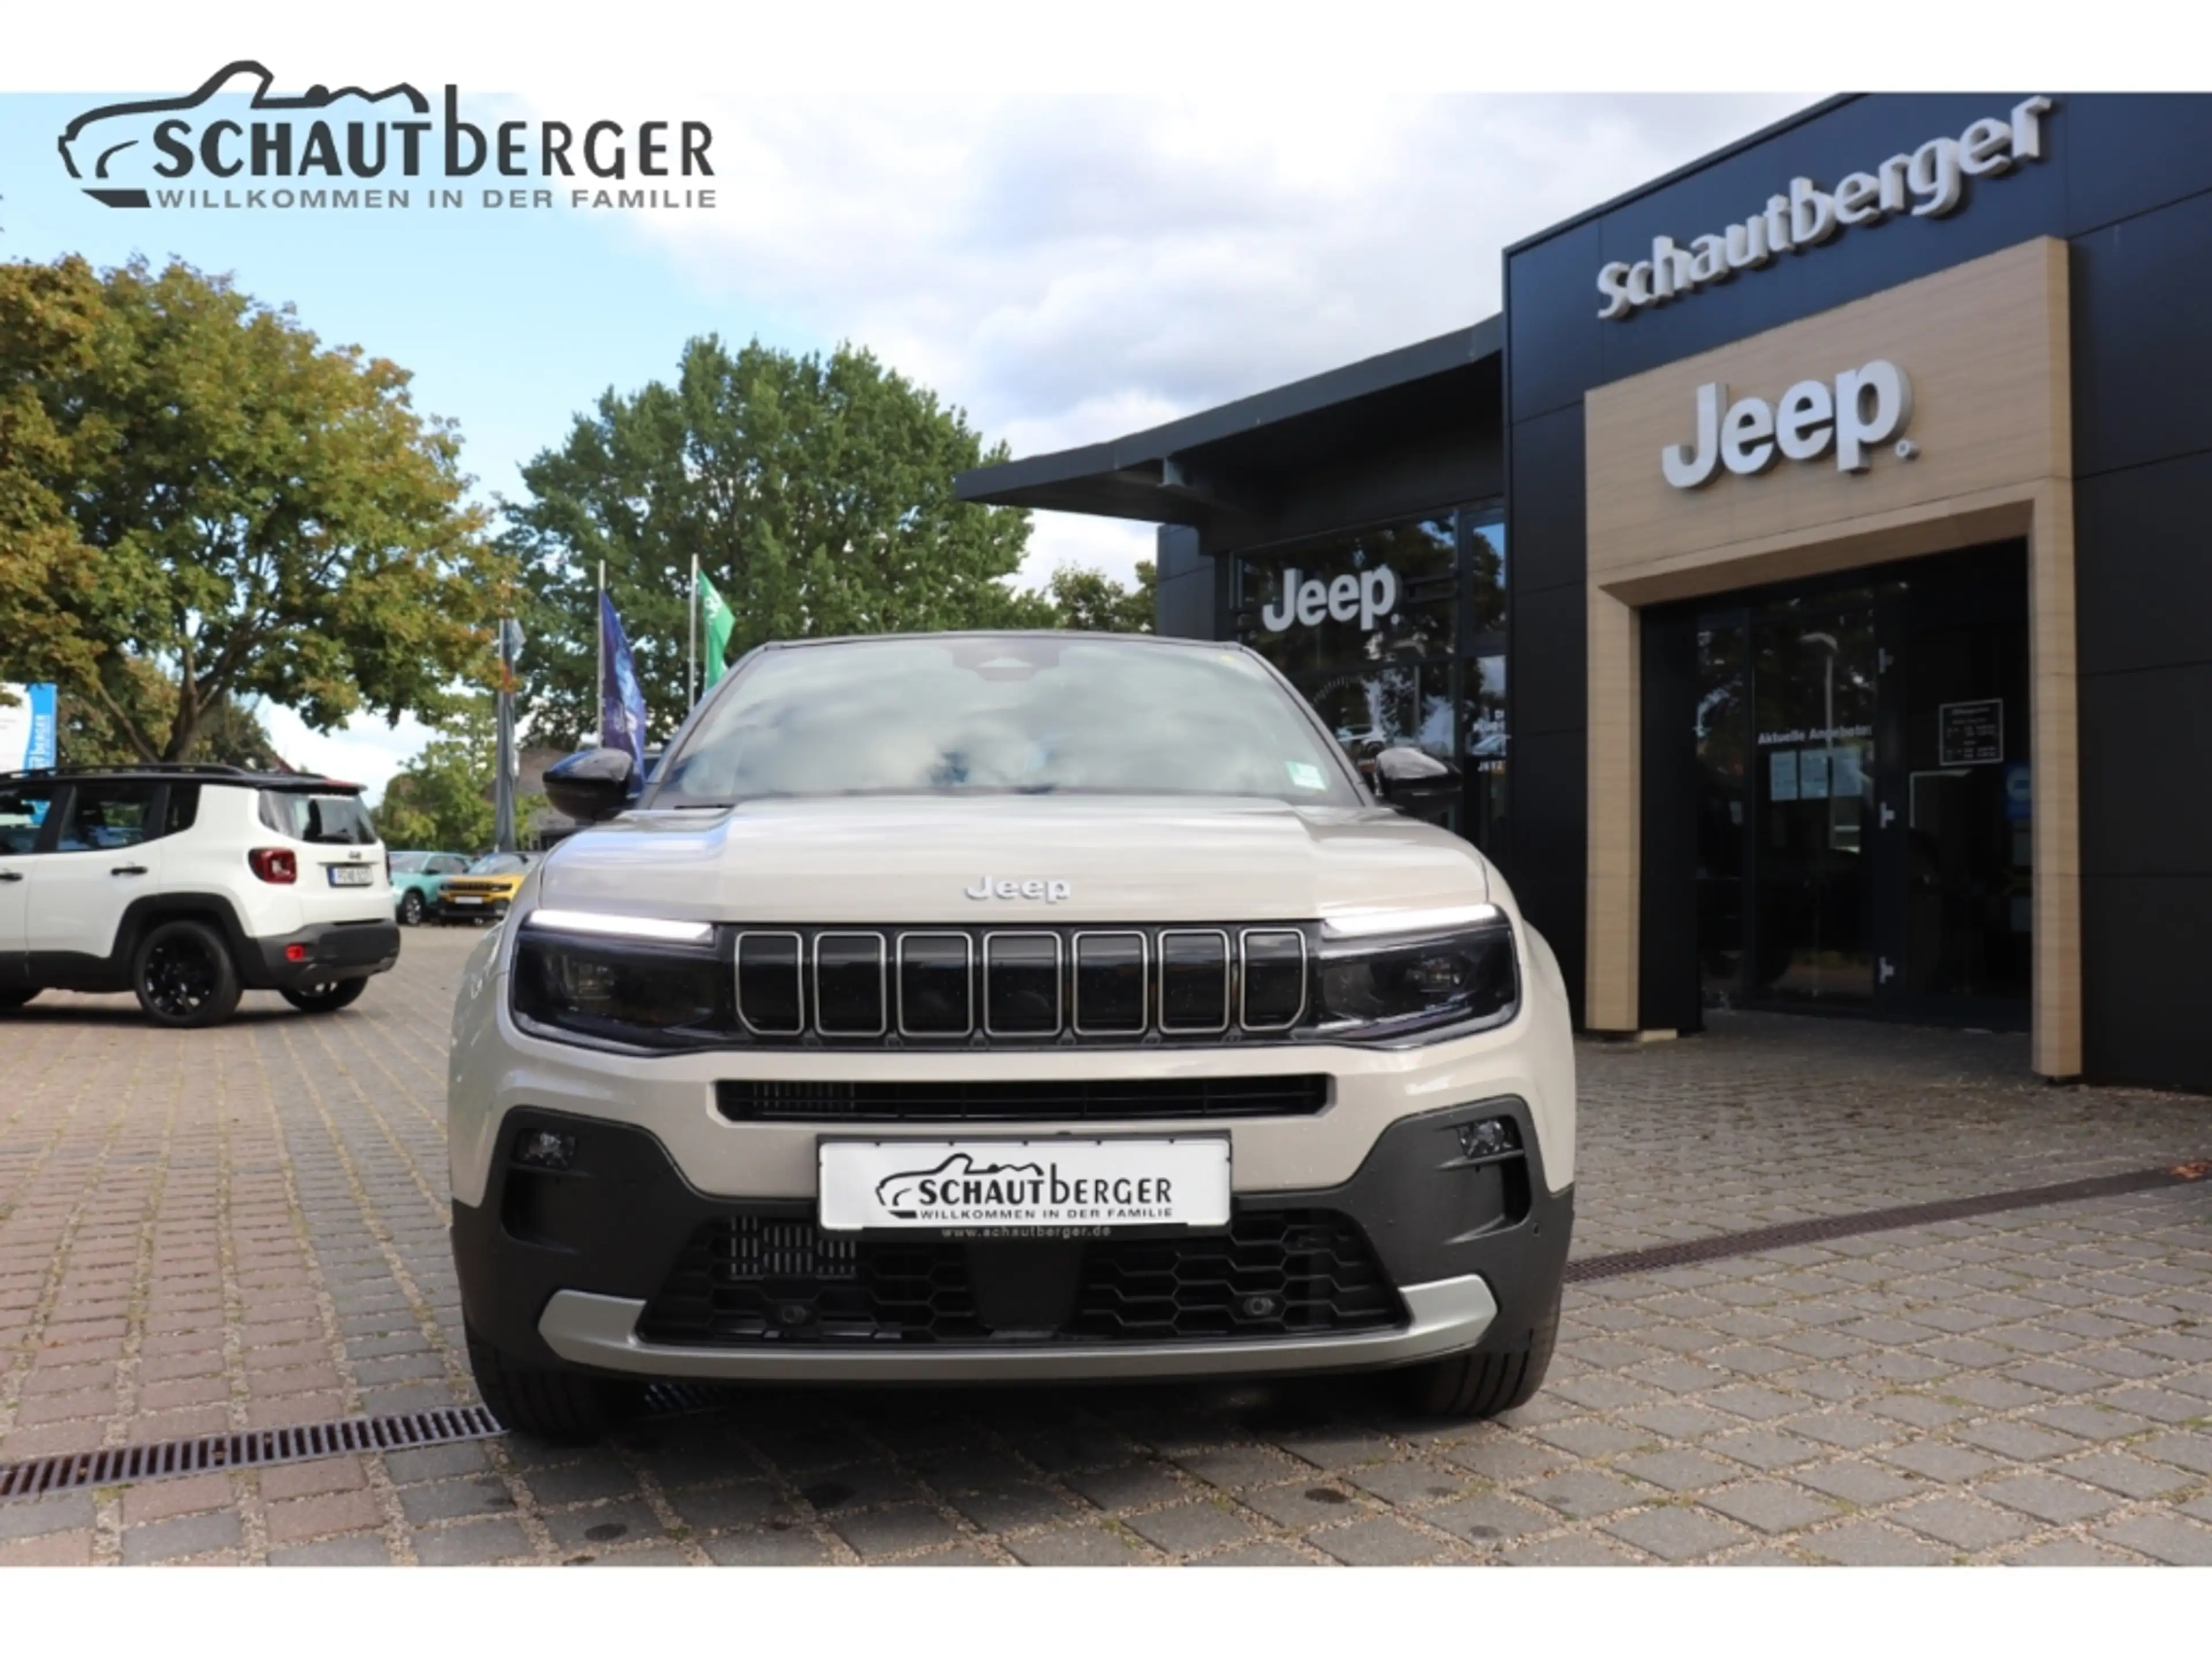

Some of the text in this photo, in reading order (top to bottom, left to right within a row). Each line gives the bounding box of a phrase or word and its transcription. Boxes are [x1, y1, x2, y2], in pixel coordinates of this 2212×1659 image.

[1597, 94, 2052, 319] Schautberger
[1662, 358, 1912, 488] Jeep
[1262, 564, 1400, 632] Jeep
[964, 874, 1071, 904] Jeep
[921, 1207, 1172, 1219] WILLKOMMEN IN DER FAMILIE
[941, 1225, 1112, 1238] www.schautberger.de
